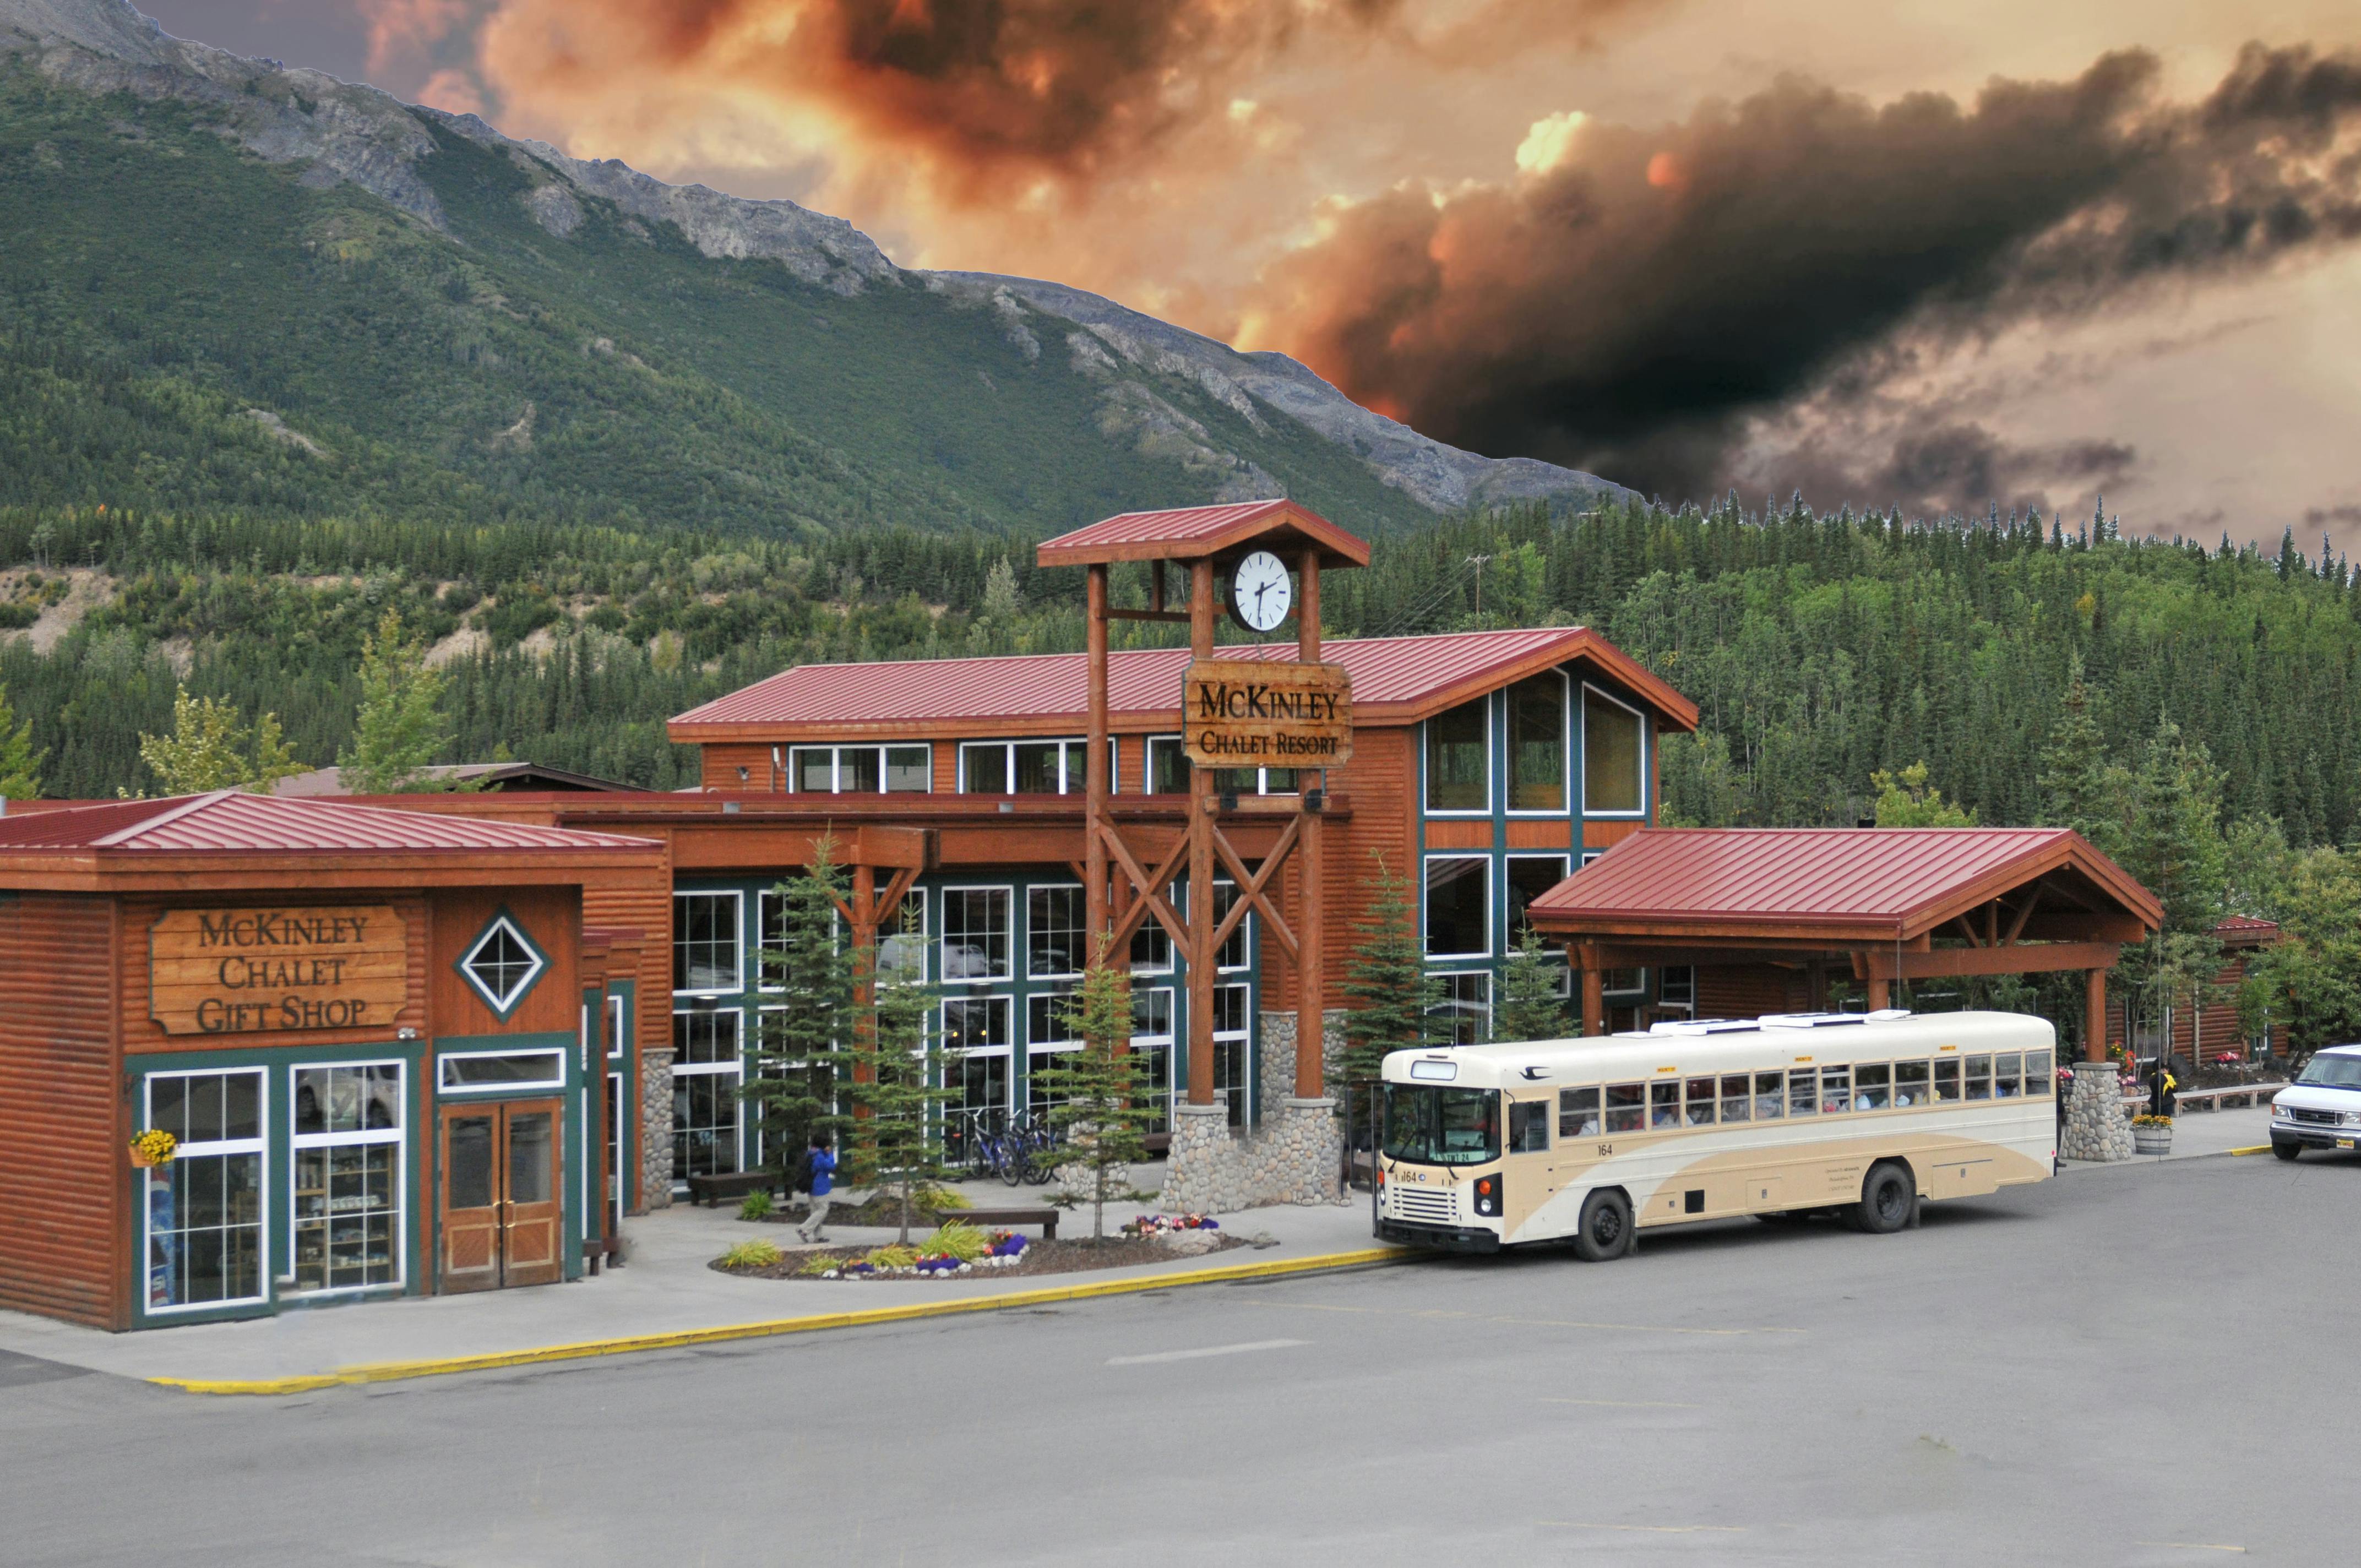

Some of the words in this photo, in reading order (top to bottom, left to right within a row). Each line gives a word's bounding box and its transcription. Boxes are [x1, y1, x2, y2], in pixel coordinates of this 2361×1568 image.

[1200, 731, 1269, 754] CHALET
[1276, 732, 1338, 755] RESORT
[219, 956, 346, 989] CHALET
[197, 998, 270, 1032] GIFT
[280, 995, 366, 1028] SHOP
[1598, 1145, 1612, 1156] 164
[1403, 1171, 1416, 1183] 164
